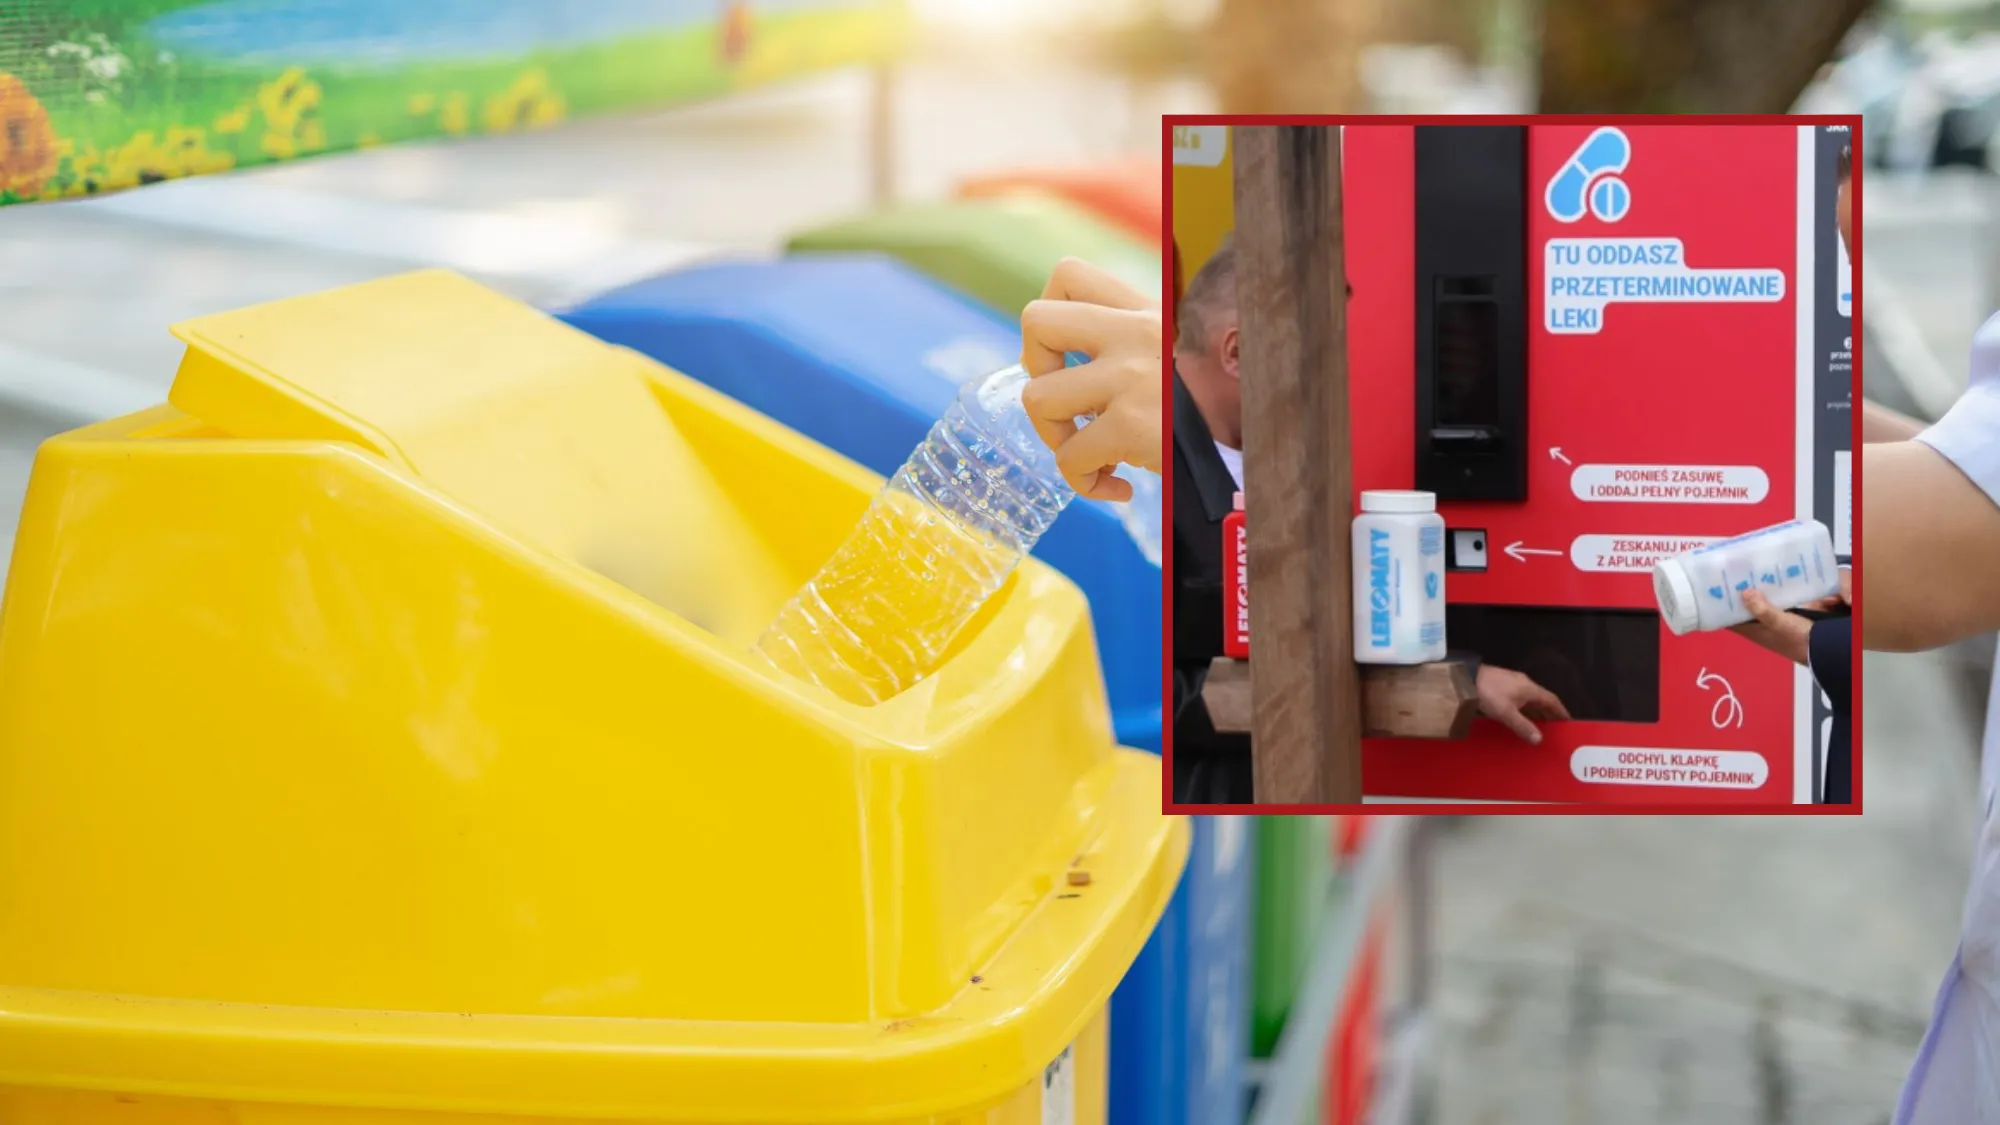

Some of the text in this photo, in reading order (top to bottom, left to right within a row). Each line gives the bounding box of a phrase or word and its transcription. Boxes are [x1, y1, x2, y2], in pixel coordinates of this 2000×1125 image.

[1551, 245, 1678, 265] TU ODDASZ
[1551, 276, 1780, 297] PRZETERMINOWANE
[1551, 308, 1598, 328] LEKI
[1614, 469, 1669, 482] PODNIEŚ
[1597, 485, 1639, 497] ODDAJ
[1684, 487, 1749, 499] POJEMNIK
[1612, 540, 1678, 553] ZESKANUJ
[1597, 555, 1604, 567] Z
[1618, 752, 1668, 765] ODCHYL
[1590, 766, 1642, 779] POBIERZ
[1645, 768, 1687, 781] PUSTY
[1690, 770, 1755, 784] POJEMNIK
